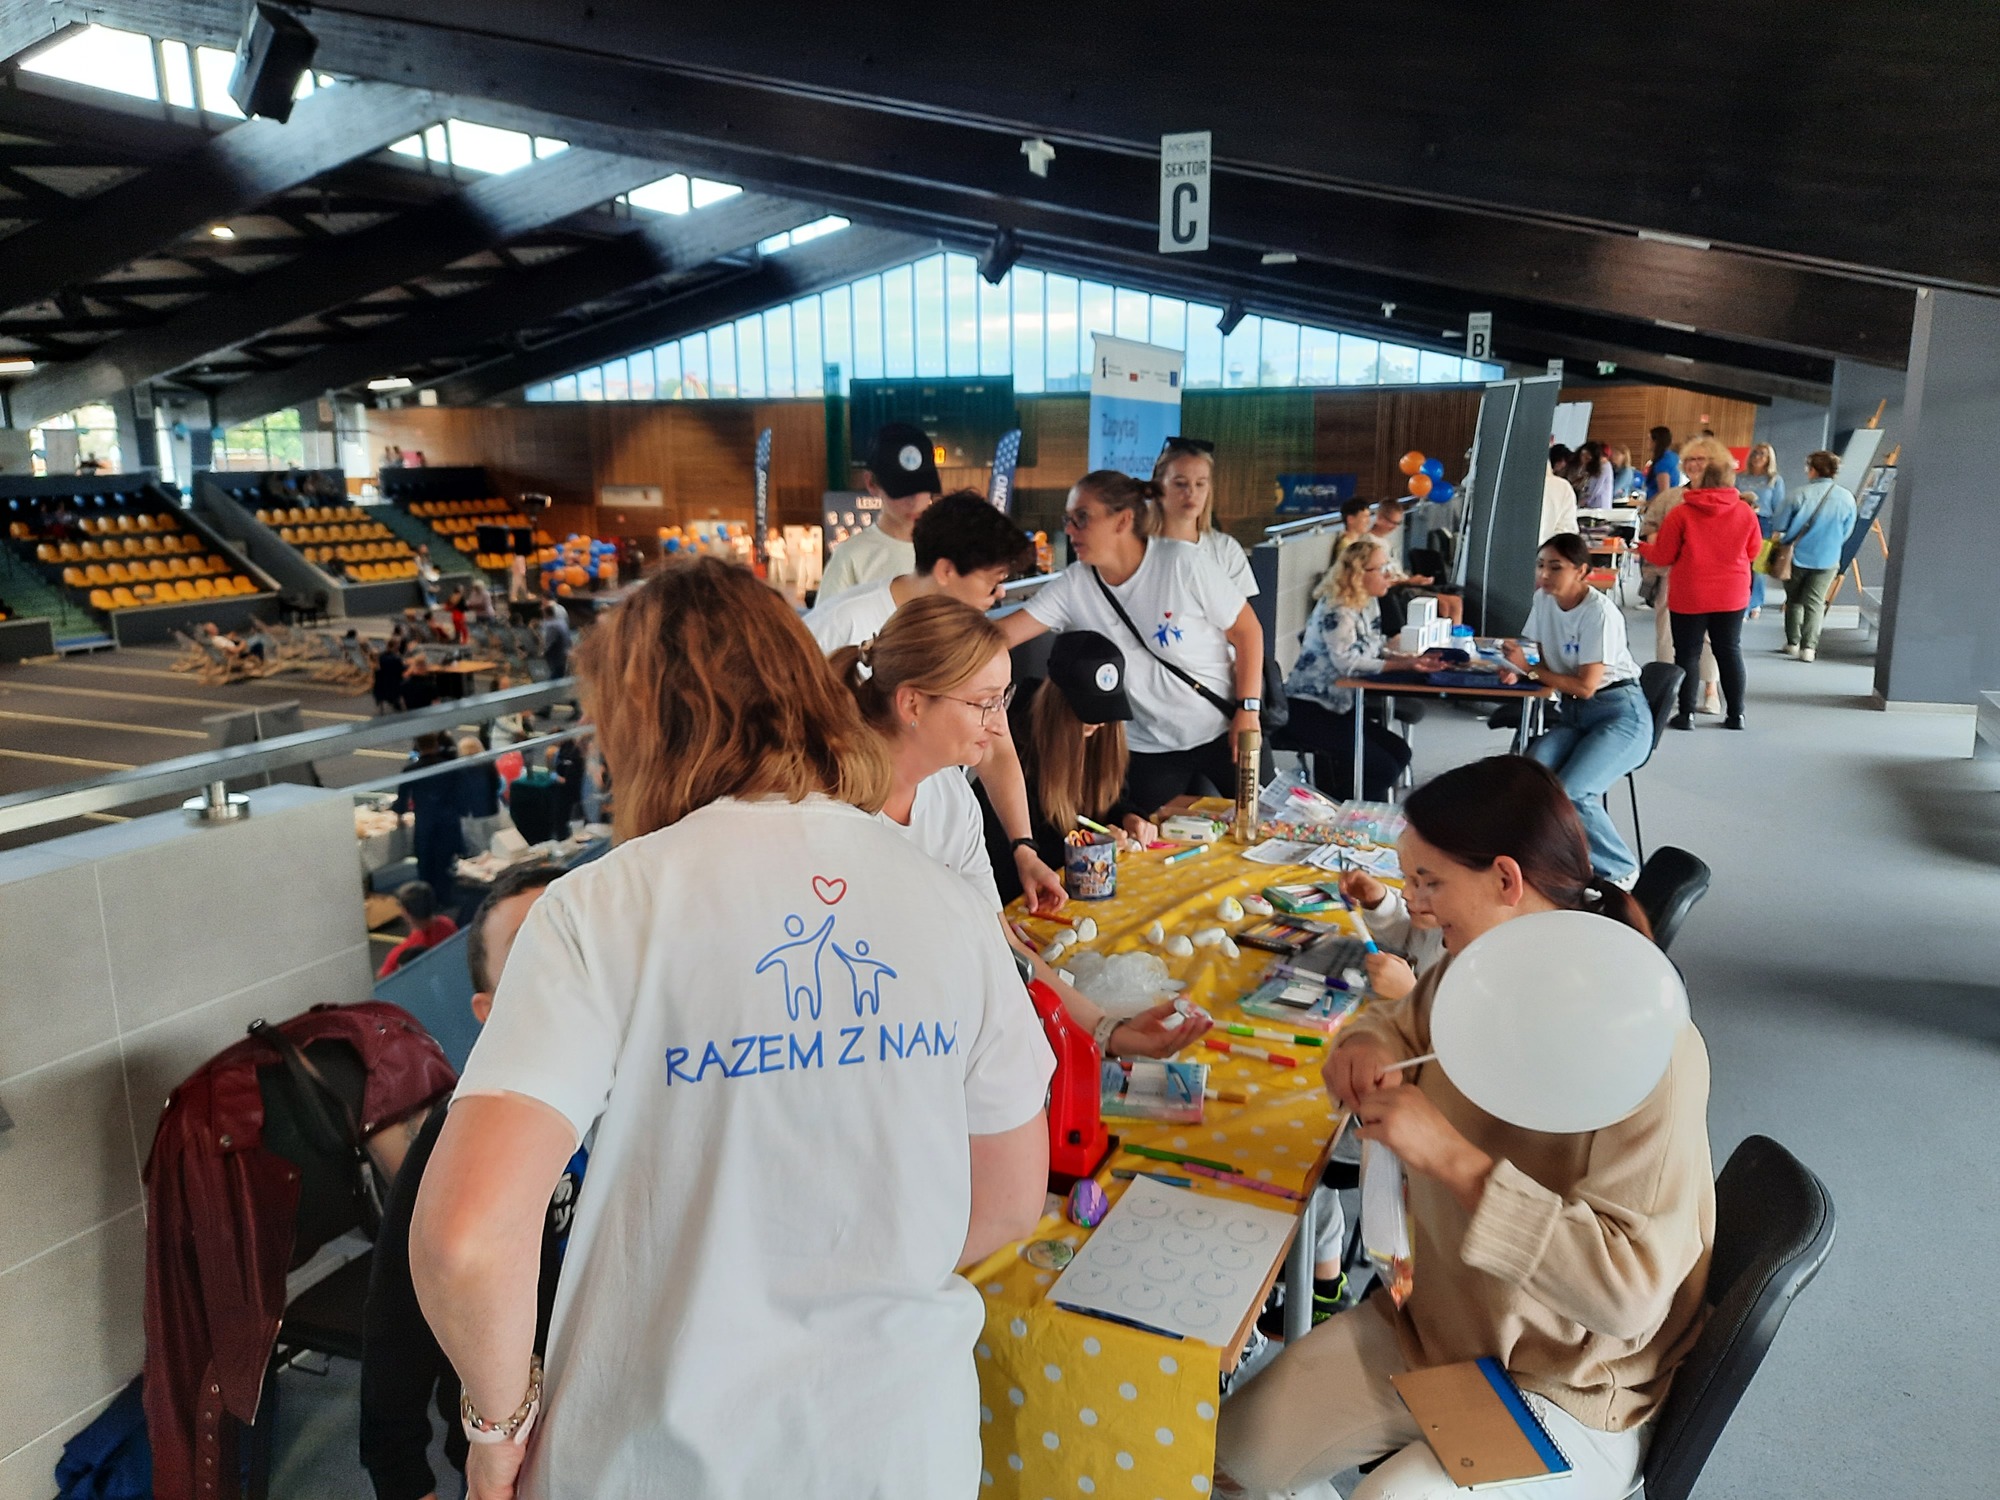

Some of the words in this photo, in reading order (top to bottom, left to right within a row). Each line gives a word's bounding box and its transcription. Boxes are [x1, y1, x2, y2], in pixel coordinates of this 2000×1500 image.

[1165, 161, 1207, 178] SEKTOR
[1172, 182, 1198, 245] C
[1473, 333, 1485, 357] B
[665, 1031, 824, 1087] RAZEM
[838, 1025, 866, 1066] Z
[880, 1020, 959, 1062] NAM
